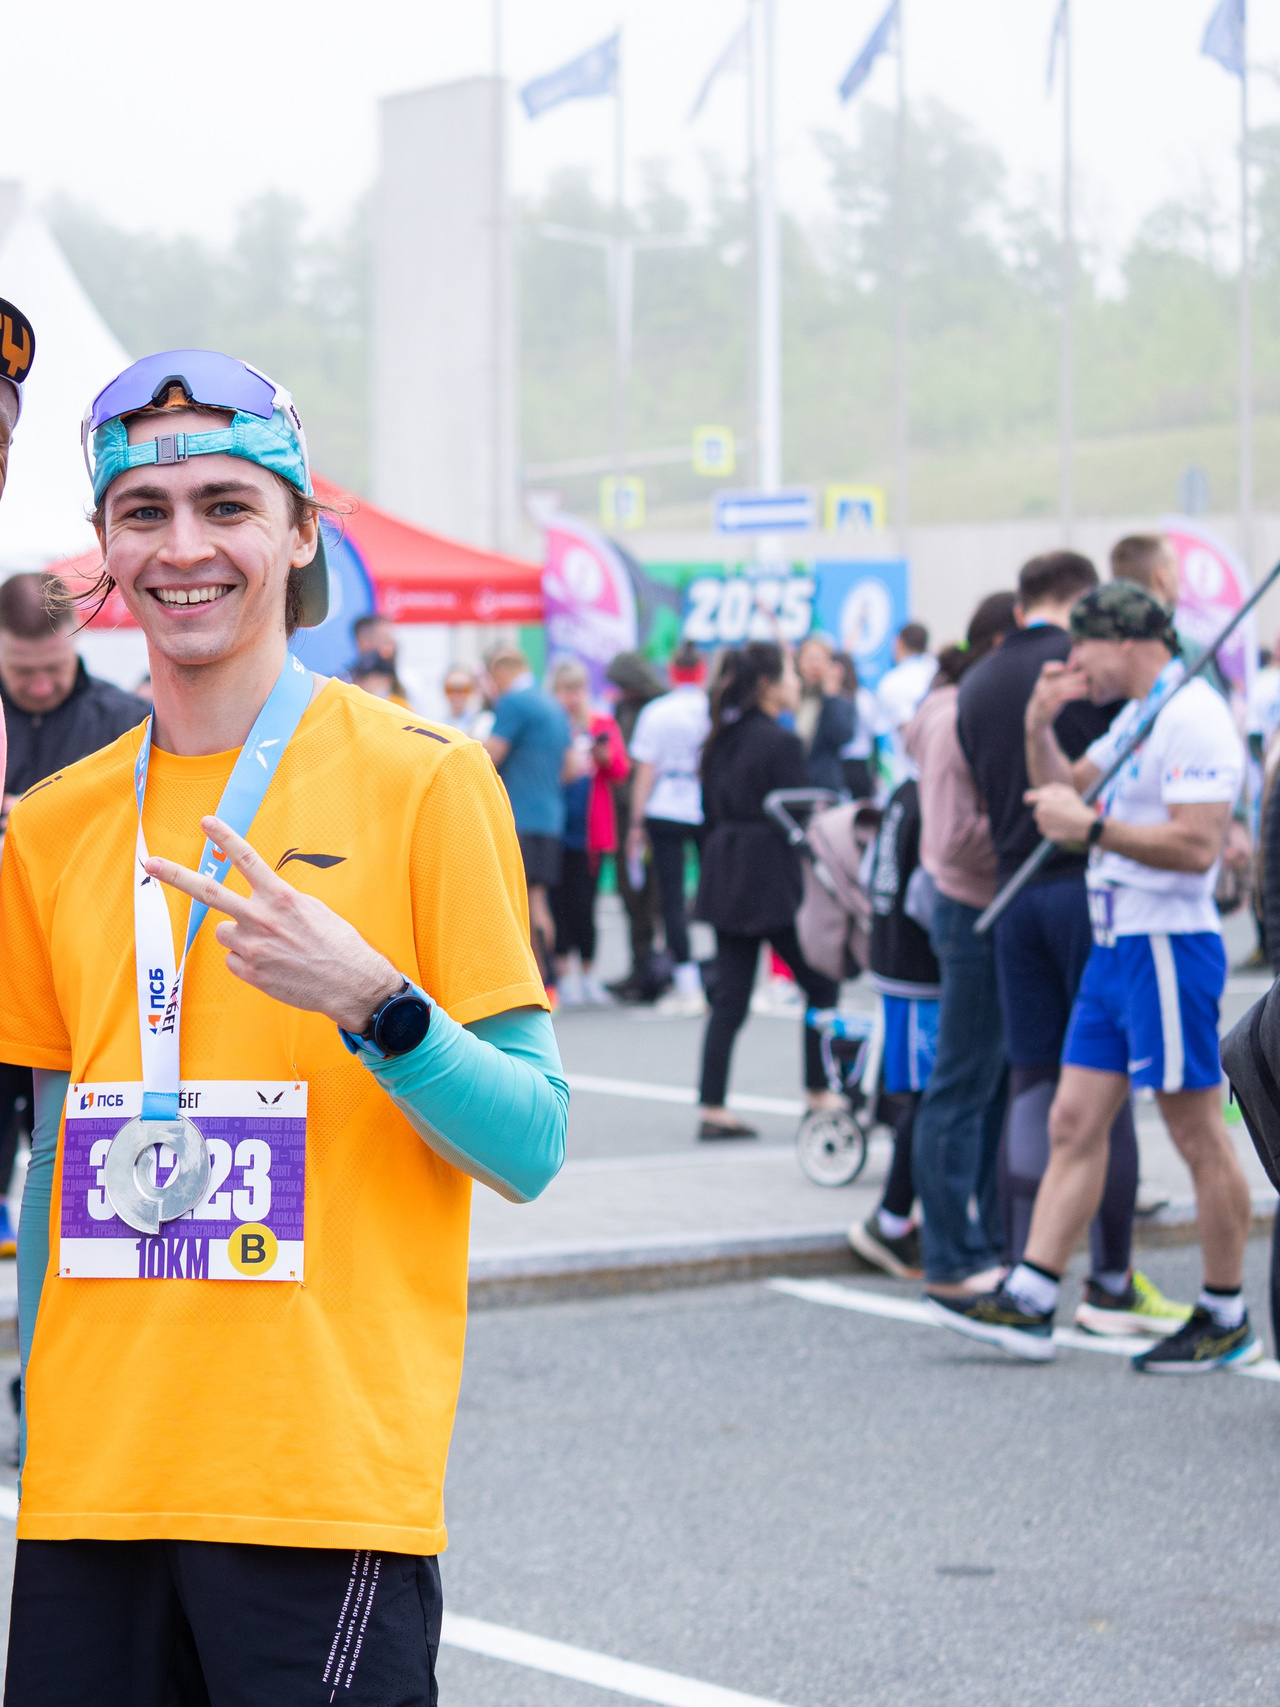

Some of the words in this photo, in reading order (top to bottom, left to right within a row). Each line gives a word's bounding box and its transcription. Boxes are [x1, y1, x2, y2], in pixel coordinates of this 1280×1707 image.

[682, 575, 818, 643] 2025
[148, 968, 166, 1009] ПСБ
[97, 1094, 124, 1107] ПСБ
[322, 1631, 341, 1683] PROFESSIONAL
[337, 1577, 356, 1629] PERFORMANCE
[333, 1654, 347, 1686] IMPROVE
[343, 1619, 356, 1652] PLAYER'S
[352, 1578, 367, 1618] OFF-COURT
[344, 1673, 353, 1689] AND
[349, 1635, 364, 1672] ON-COURT
[359, 1581, 378, 1633] PERFORMANCE
[373, 1558, 382, 1579] LEVEL
